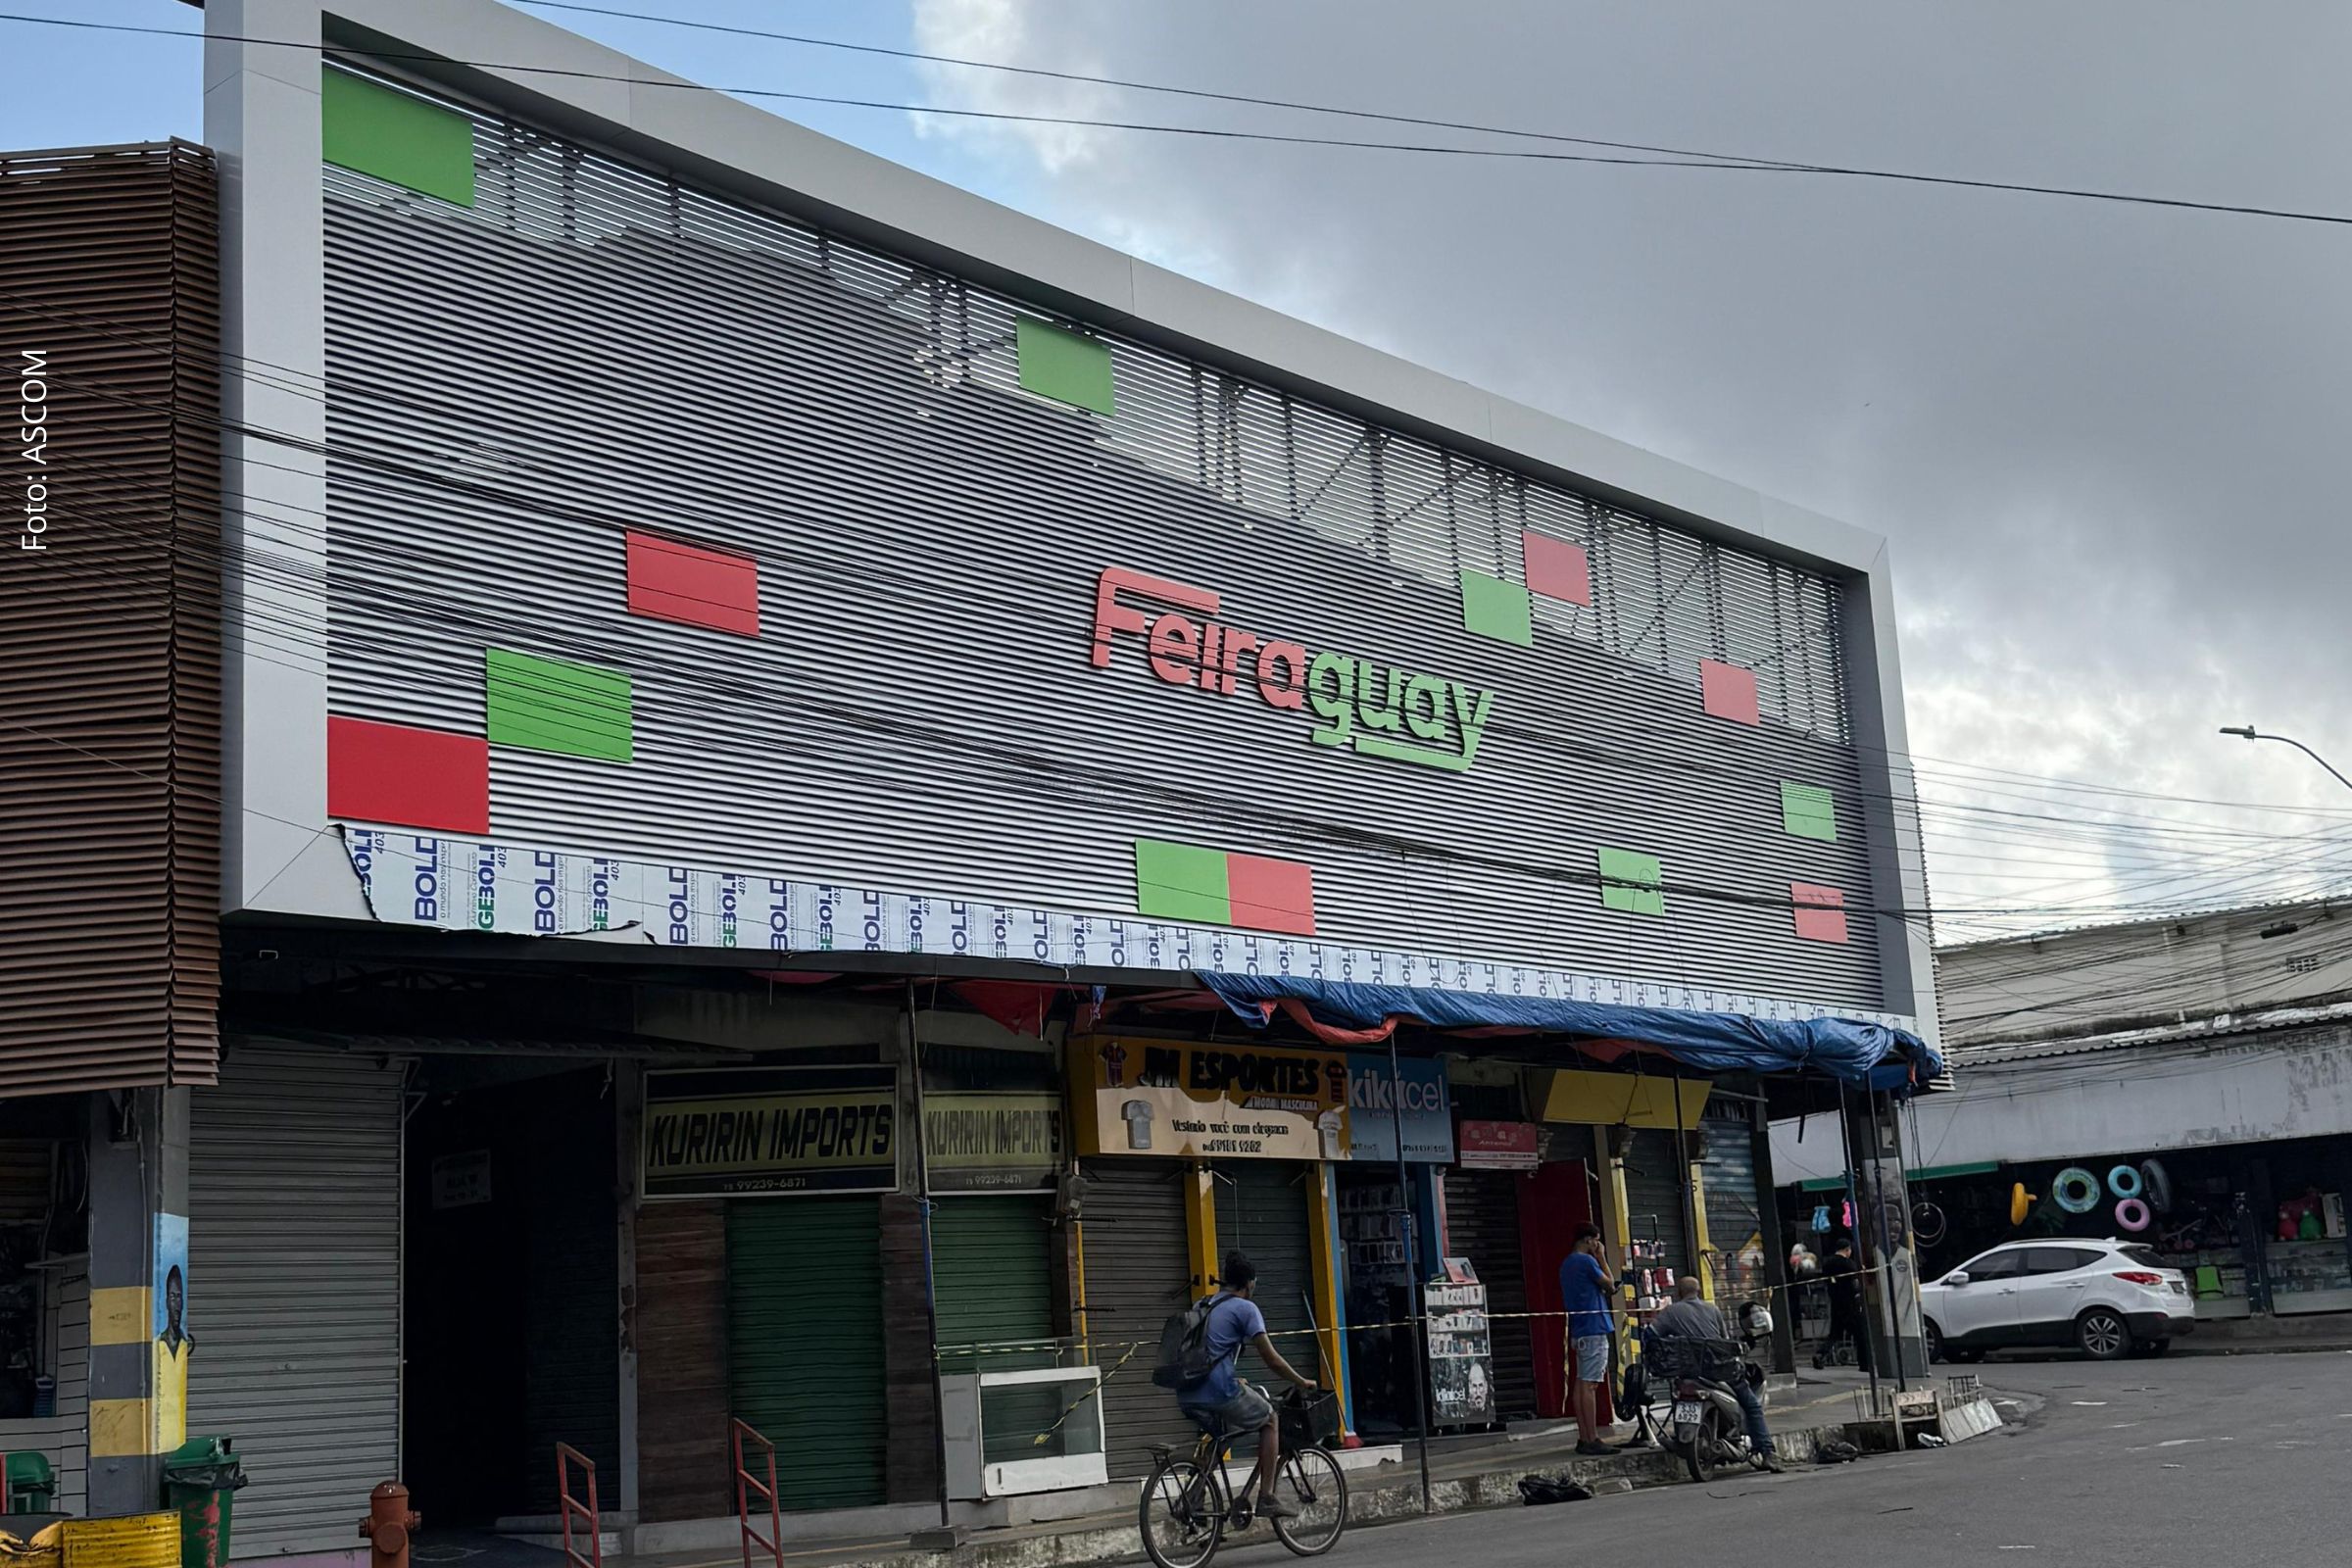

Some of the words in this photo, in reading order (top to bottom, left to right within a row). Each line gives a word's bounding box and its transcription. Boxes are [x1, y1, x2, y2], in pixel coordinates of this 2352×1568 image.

[1091, 566, 1495, 772] Feiraguay
[1190, 1051, 1319, 1095] ESPORTES
[649, 1109, 764, 1167] KURIRIN
[768, 1103, 893, 1160] IMPORTS
[926, 1109, 990, 1156] KURIRIN
[995, 1109, 1060, 1154] IMPORTS
[1233, 1124, 1250, 1134] com
